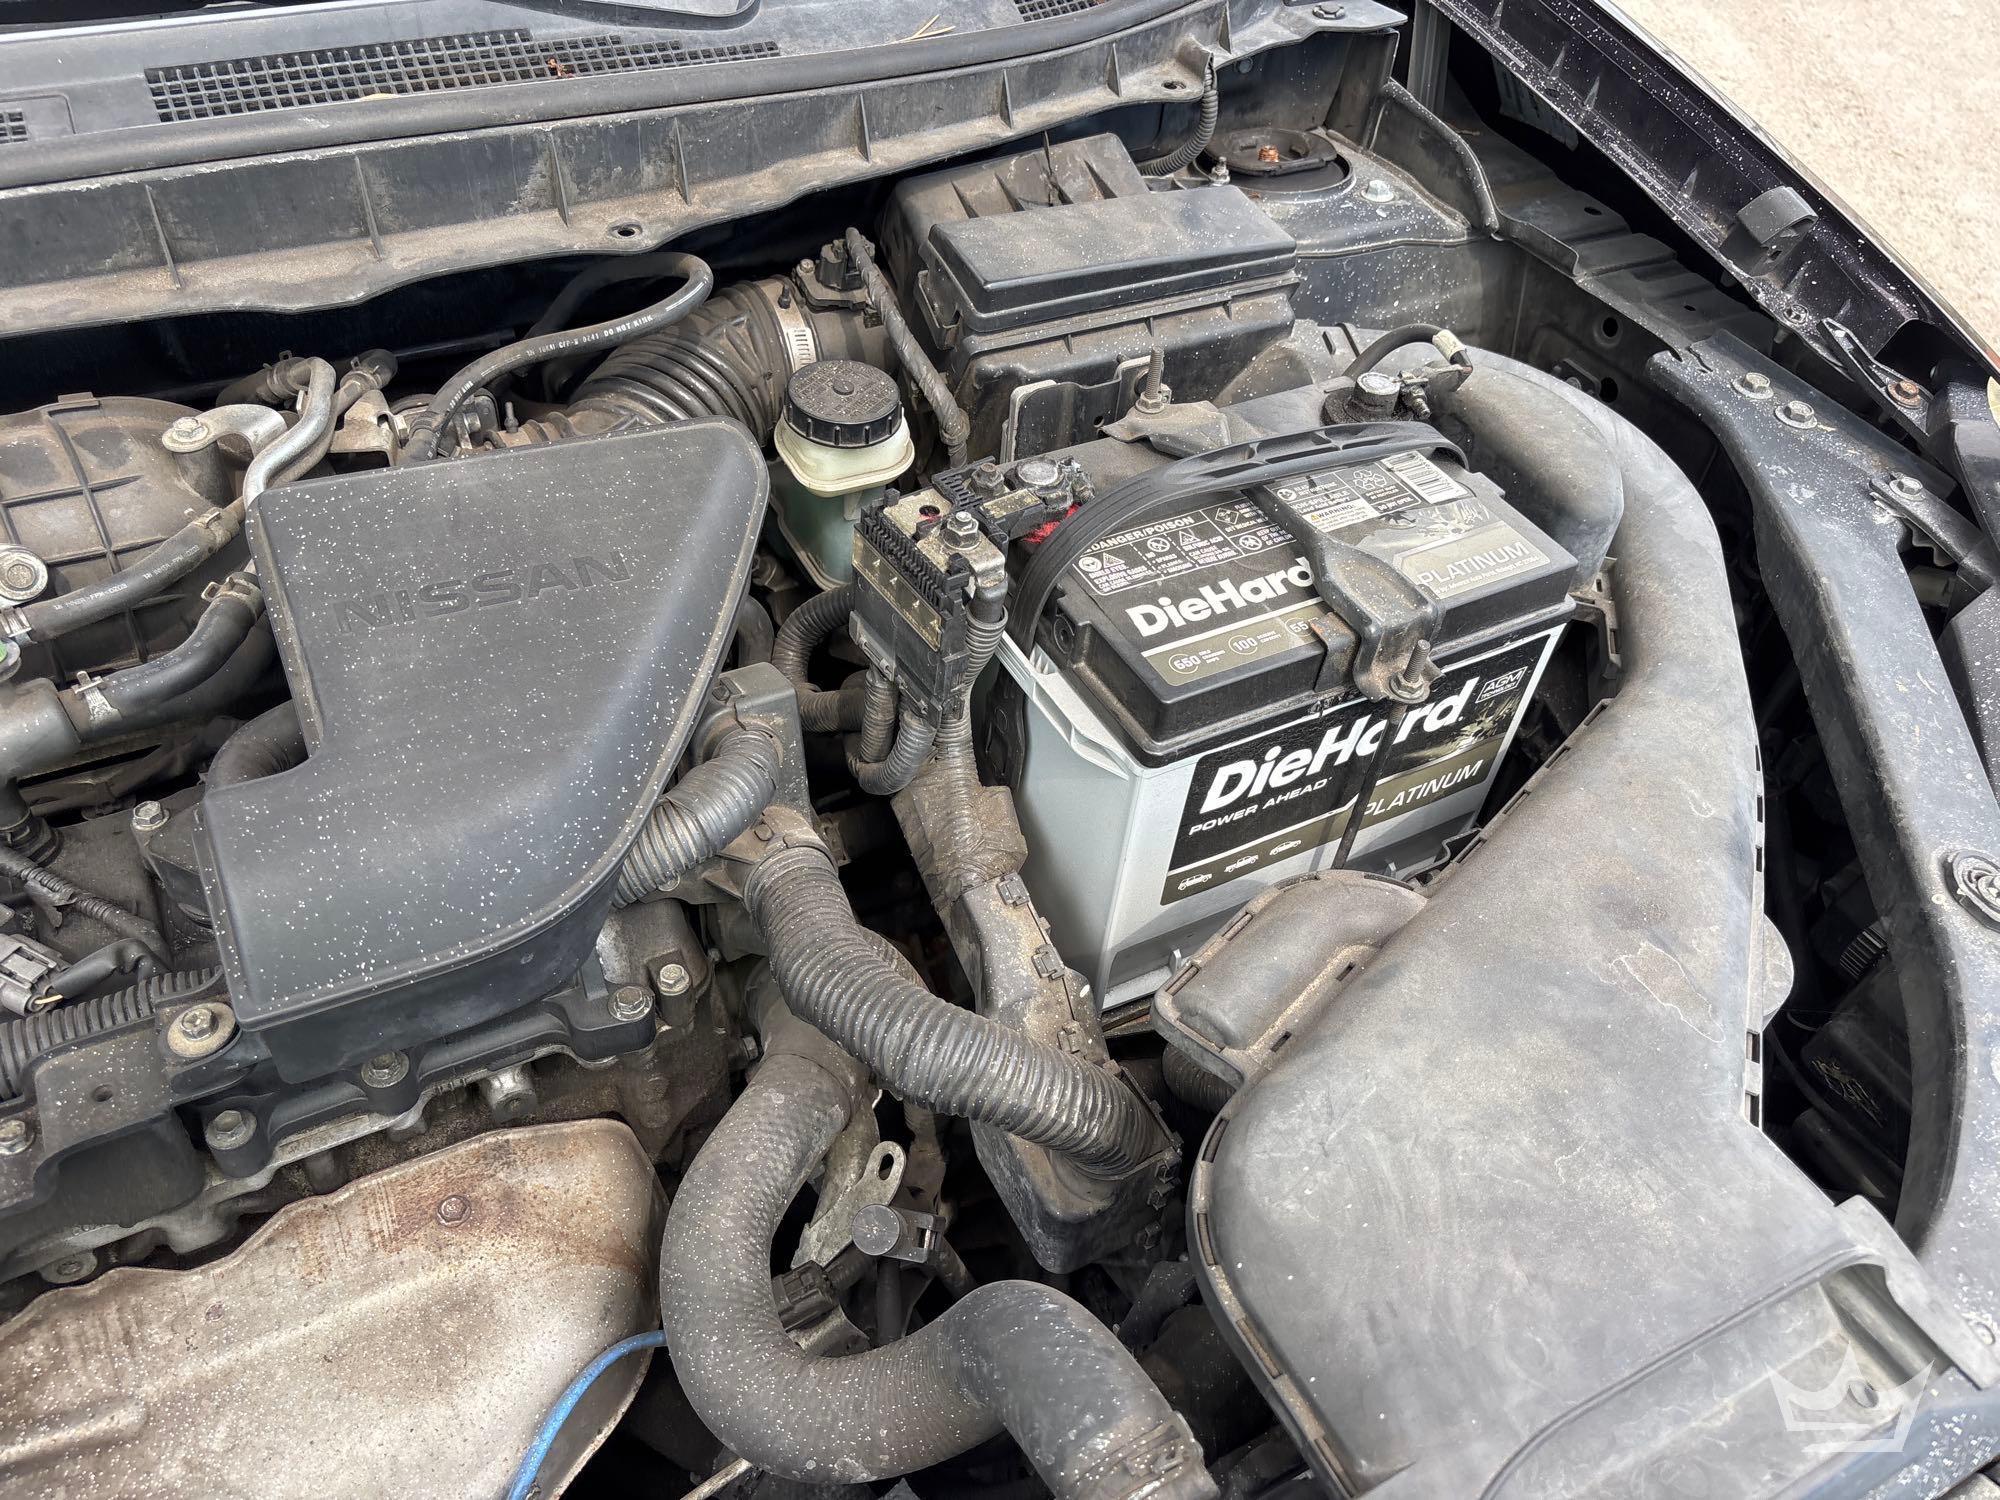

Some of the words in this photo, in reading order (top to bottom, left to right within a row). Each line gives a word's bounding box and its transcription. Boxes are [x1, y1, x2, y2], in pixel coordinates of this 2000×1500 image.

[603, 328, 614, 338] DO
[616, 322, 631, 333] NOT
[633, 315, 653, 328] KINK
[1091, 516, 1195, 550] DANGER/POISON
[1417, 541, 1530, 586] PLATINUM
[332, 550, 631, 633] NISSAN
[1125, 556, 1315, 638] DieHard
[1231, 636, 1258, 652] 100
[1290, 621, 1309, 633] 55
[1173, 654, 1201, 671] 650
[1483, 670, 1523, 693] AGM
[1364, 759, 1484, 817] PLATINUM
[1189, 804, 1257, 836] POWER
[1263, 777, 1329, 811] AHEAD
